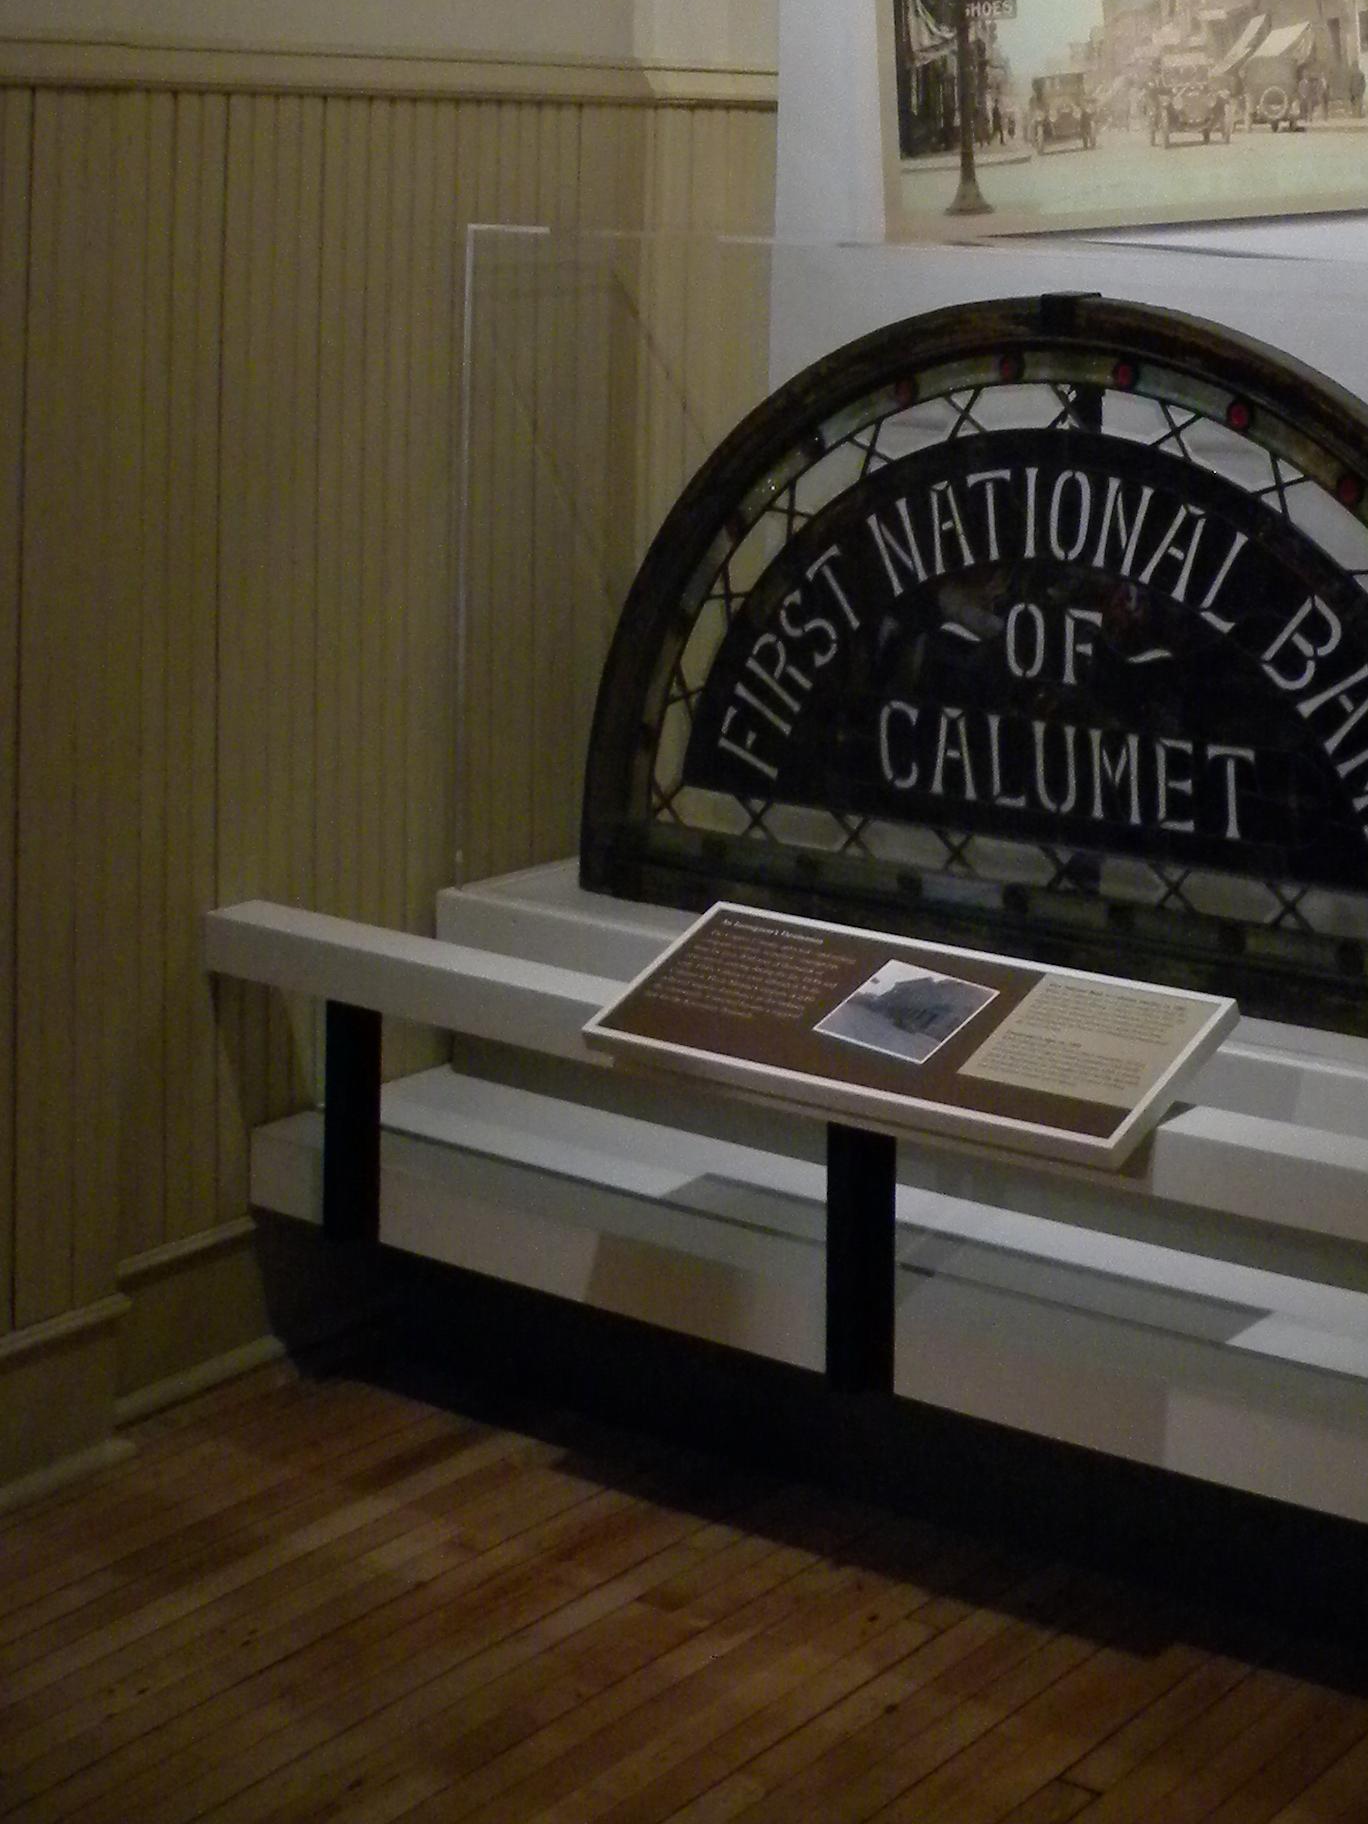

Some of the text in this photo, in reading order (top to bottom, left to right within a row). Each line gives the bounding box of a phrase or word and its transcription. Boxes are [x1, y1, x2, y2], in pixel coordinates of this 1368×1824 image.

[719, 545, 857, 779] FIRST
[868, 468, 1250, 634] NATIONAL
[1007, 603, 1103, 684] OF
[880, 701, 1255, 838] CALUMET
